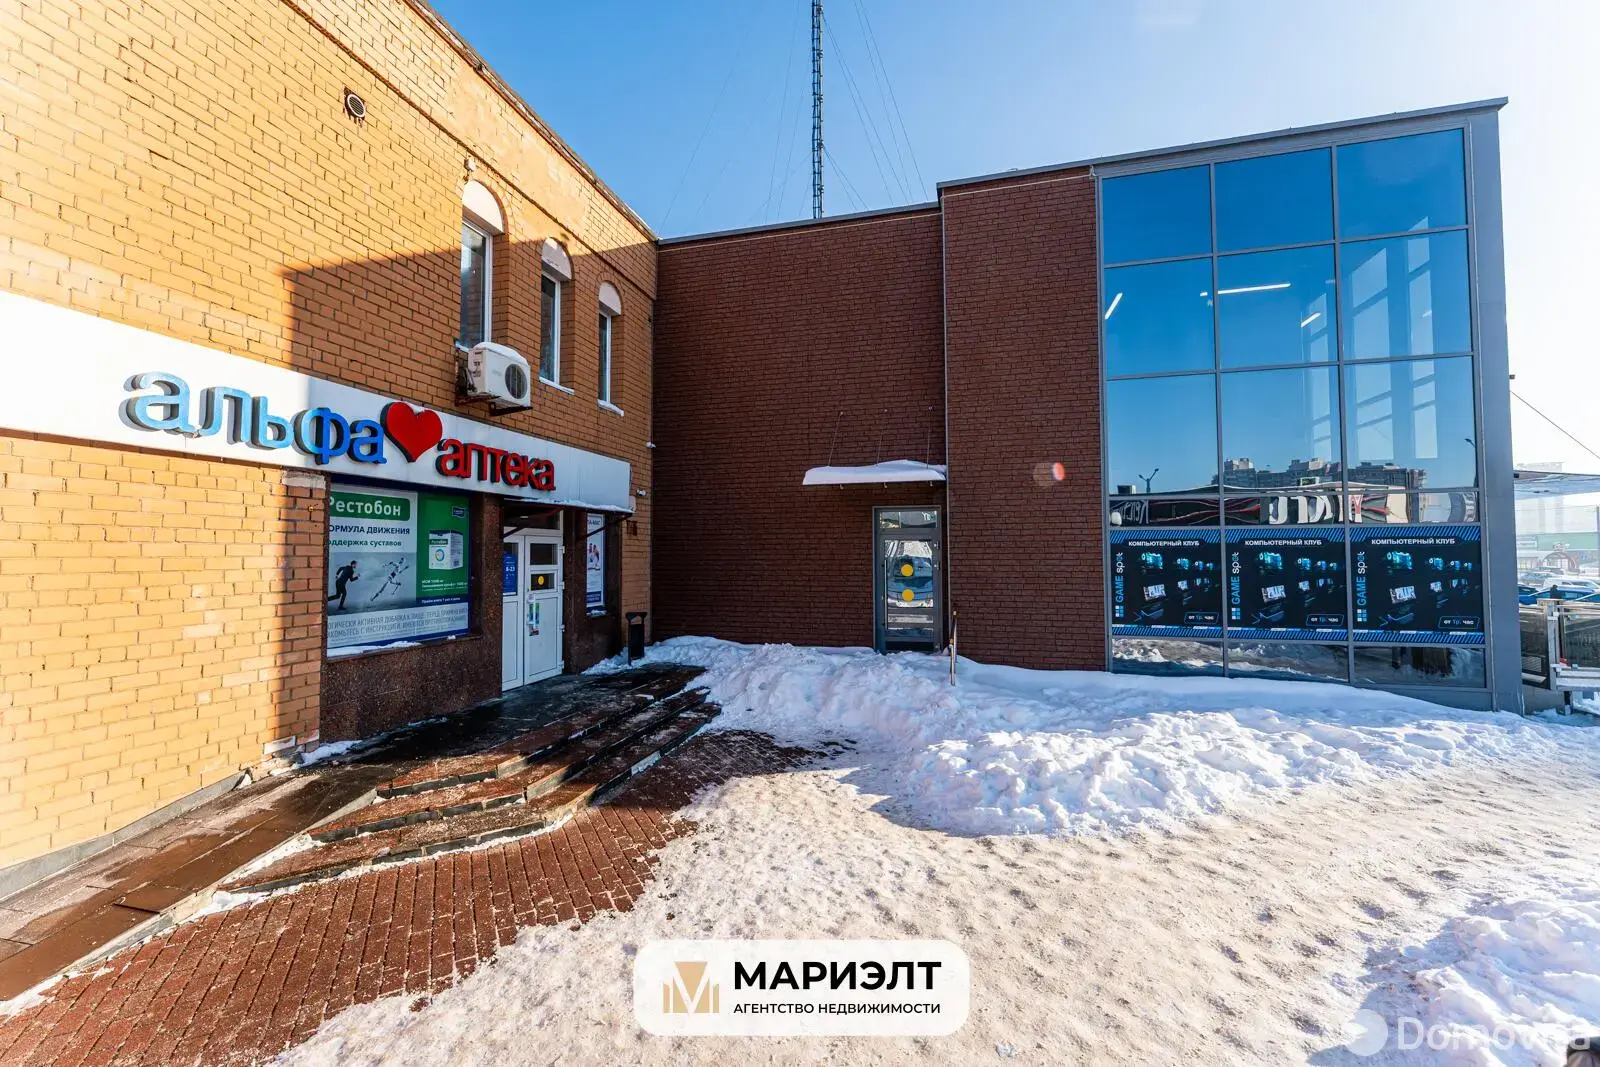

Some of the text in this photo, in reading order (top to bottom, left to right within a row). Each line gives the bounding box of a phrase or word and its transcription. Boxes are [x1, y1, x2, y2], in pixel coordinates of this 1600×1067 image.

[119, 372, 556, 492] альфа аптека
[367, 526, 410, 535] ДВИЖЕНИЯ
[1128, 539, 1182, 547] КОМПЬЮТЕРНЫЙ
[1371, 537, 1434, 545] КОМПЬЮТЕРНЫЙ
[1114, 575, 1124, 603] GAME
[1231, 576, 1240, 605] GAME
[1356, 576, 1367, 606] GAME
